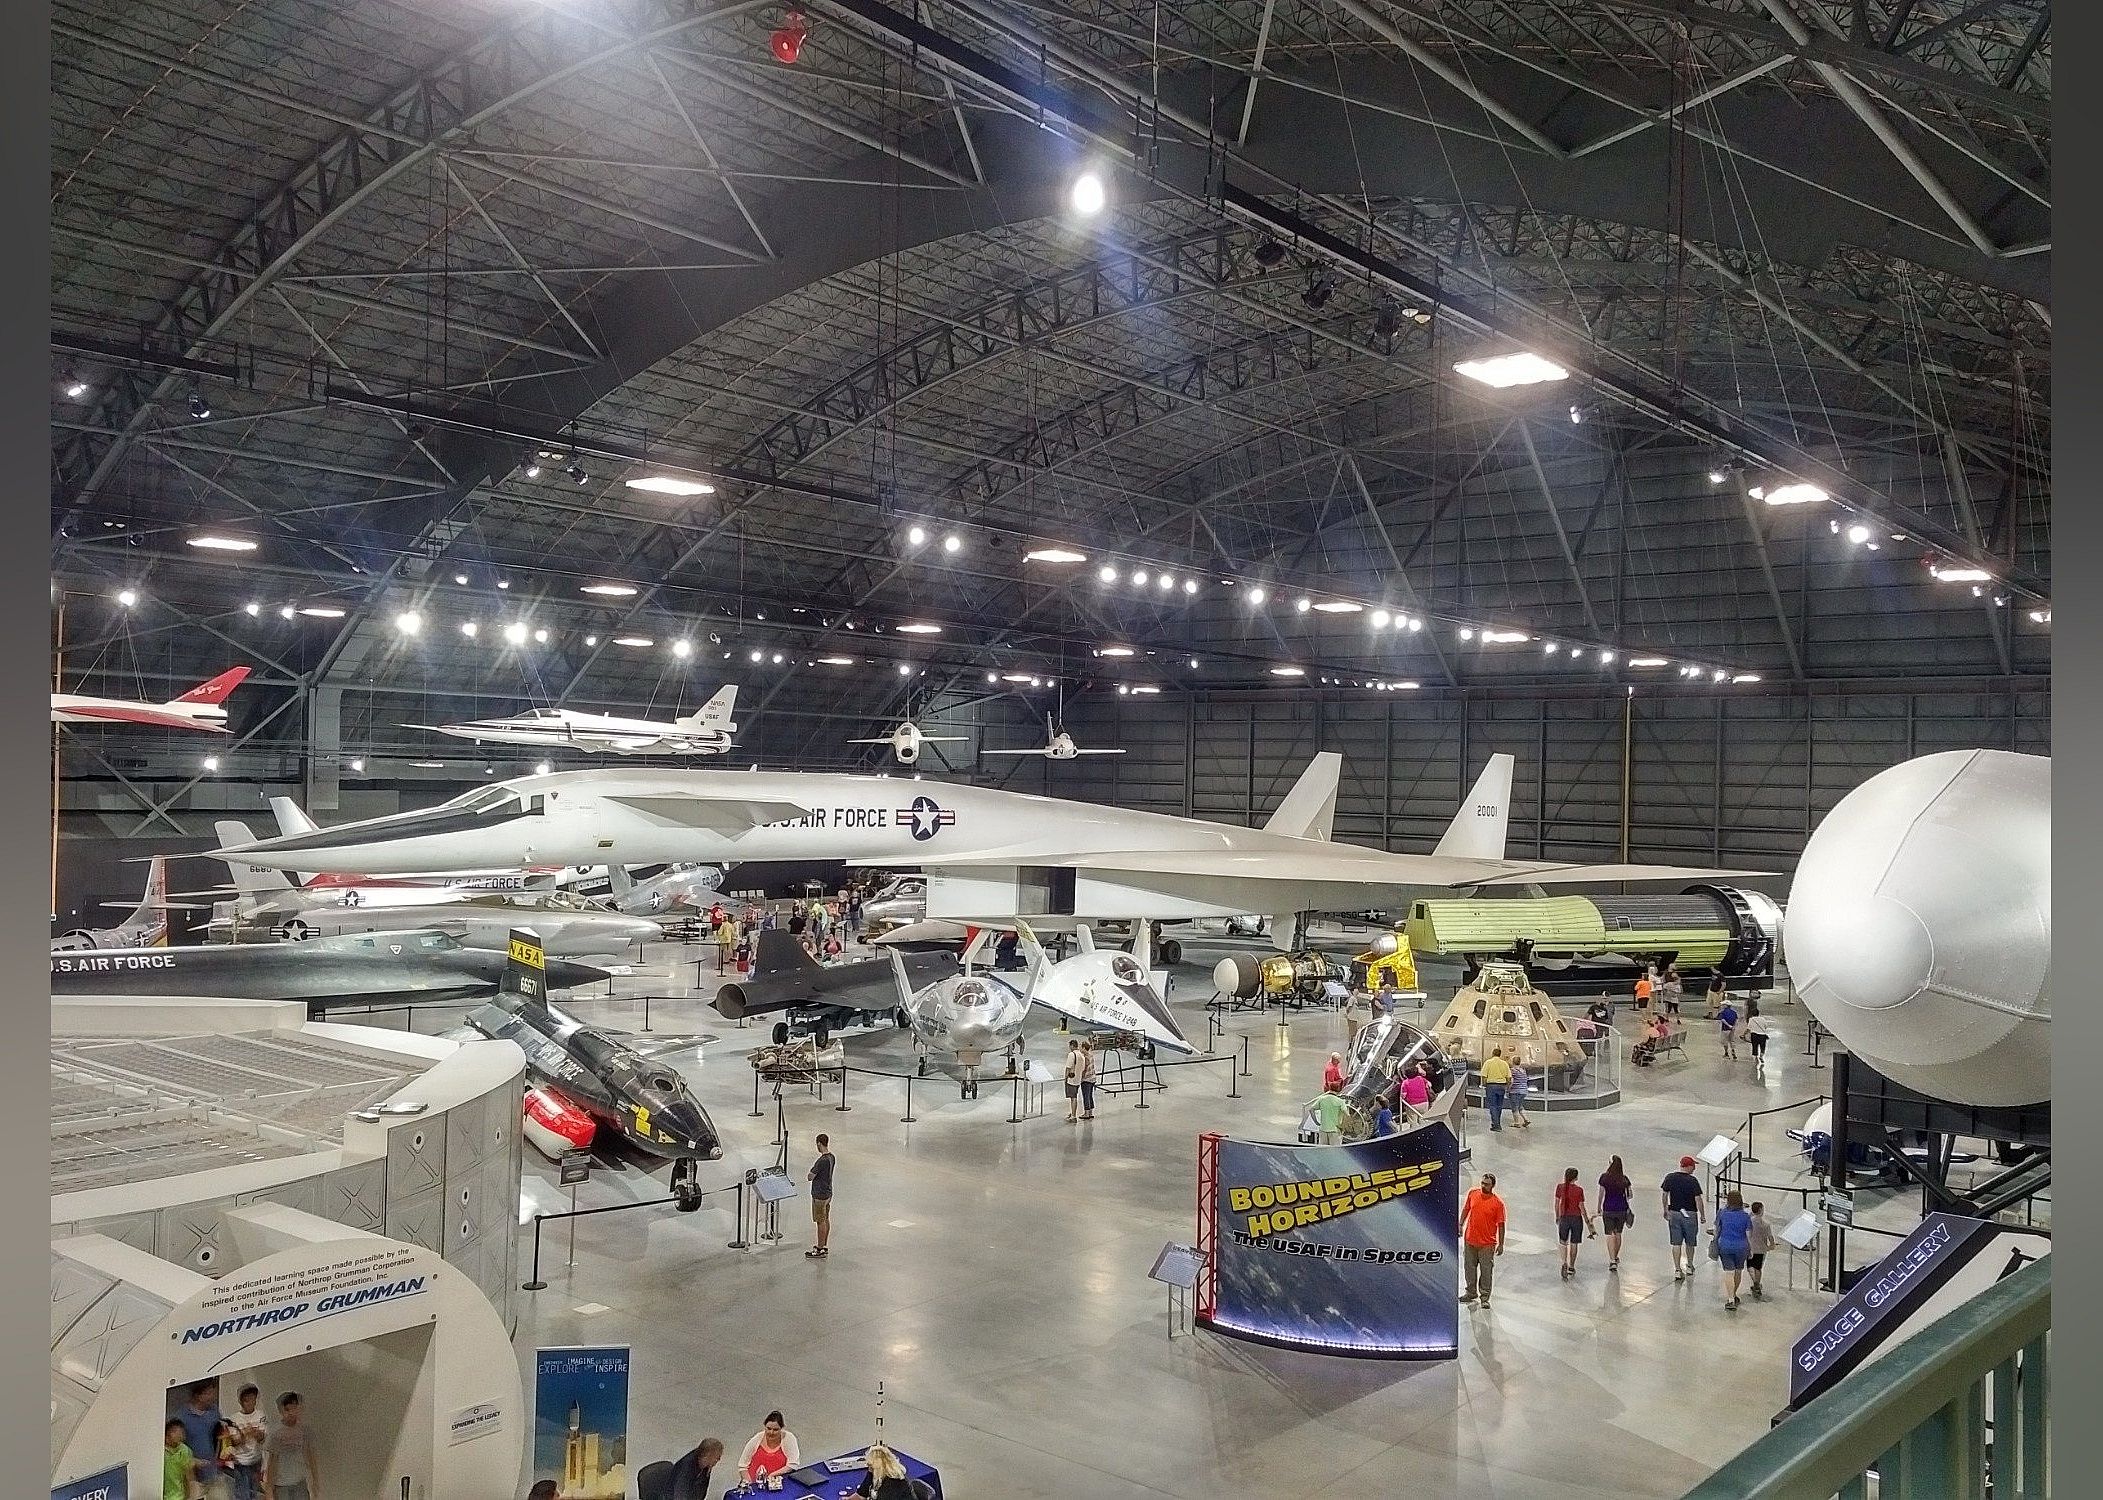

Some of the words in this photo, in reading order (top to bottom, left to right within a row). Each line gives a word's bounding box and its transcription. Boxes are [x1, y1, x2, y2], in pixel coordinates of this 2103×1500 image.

[834, 808, 887, 828] FORCE
[1477, 804, 1498, 817] 20001
[486, 877, 521, 889] FORCE
[113, 955, 176, 970] FORCE
[510, 941, 540, 964] NASA
[1229, 1160, 1444, 1212] BOUNDLESS
[1247, 1175, 1432, 1239] HORIZONS
[1232, 1230, 1270, 1250] The
[1272, 1237, 1332, 1258] USAF
[1335, 1244, 1359, 1262] in
[1363, 1248, 1443, 1265] Space
[201, 1295, 235, 1309] inspired
[237, 1284, 285, 1301] contribution
[287, 1281, 296, 1290] of
[297, 1274, 332, 1287] Northrop
[334, 1266, 371, 1280] Grumman
[372, 1256, 415, 1271] Corporation
[212, 1286, 230, 1295] This
[232, 1276, 272, 1292] dedicated
[274, 1270, 305, 1282] learning
[306, 1264, 330, 1276] space
[331, 1260, 353, 1270] made
[354, 1252, 385, 1266] possible
[386, 1250, 395, 1259] by
[397, 1247, 410, 1256] the
[230, 1305, 239, 1313] to
[241, 1302, 255, 1311] the
[257, 1298, 269, 1307] Air
[271, 1294, 293, 1304] Force
[295, 1285, 329, 1299] Museum
[330, 1275, 374, 1290] Foundation,
[1798, 1307, 1866, 1372] SPACE
[1864, 1222, 1951, 1308] GALLERY
[181, 1303, 310, 1345] NORTHROP
[316, 1276, 425, 1312] GRUMMAN
[538, 1363, 580, 1375] EXPLORE
[595, 1363, 628, 1373] INSPIRE
[567, 1357, 595, 1365] IMAGINE
[71, 1485, 111, 1500] ERY
